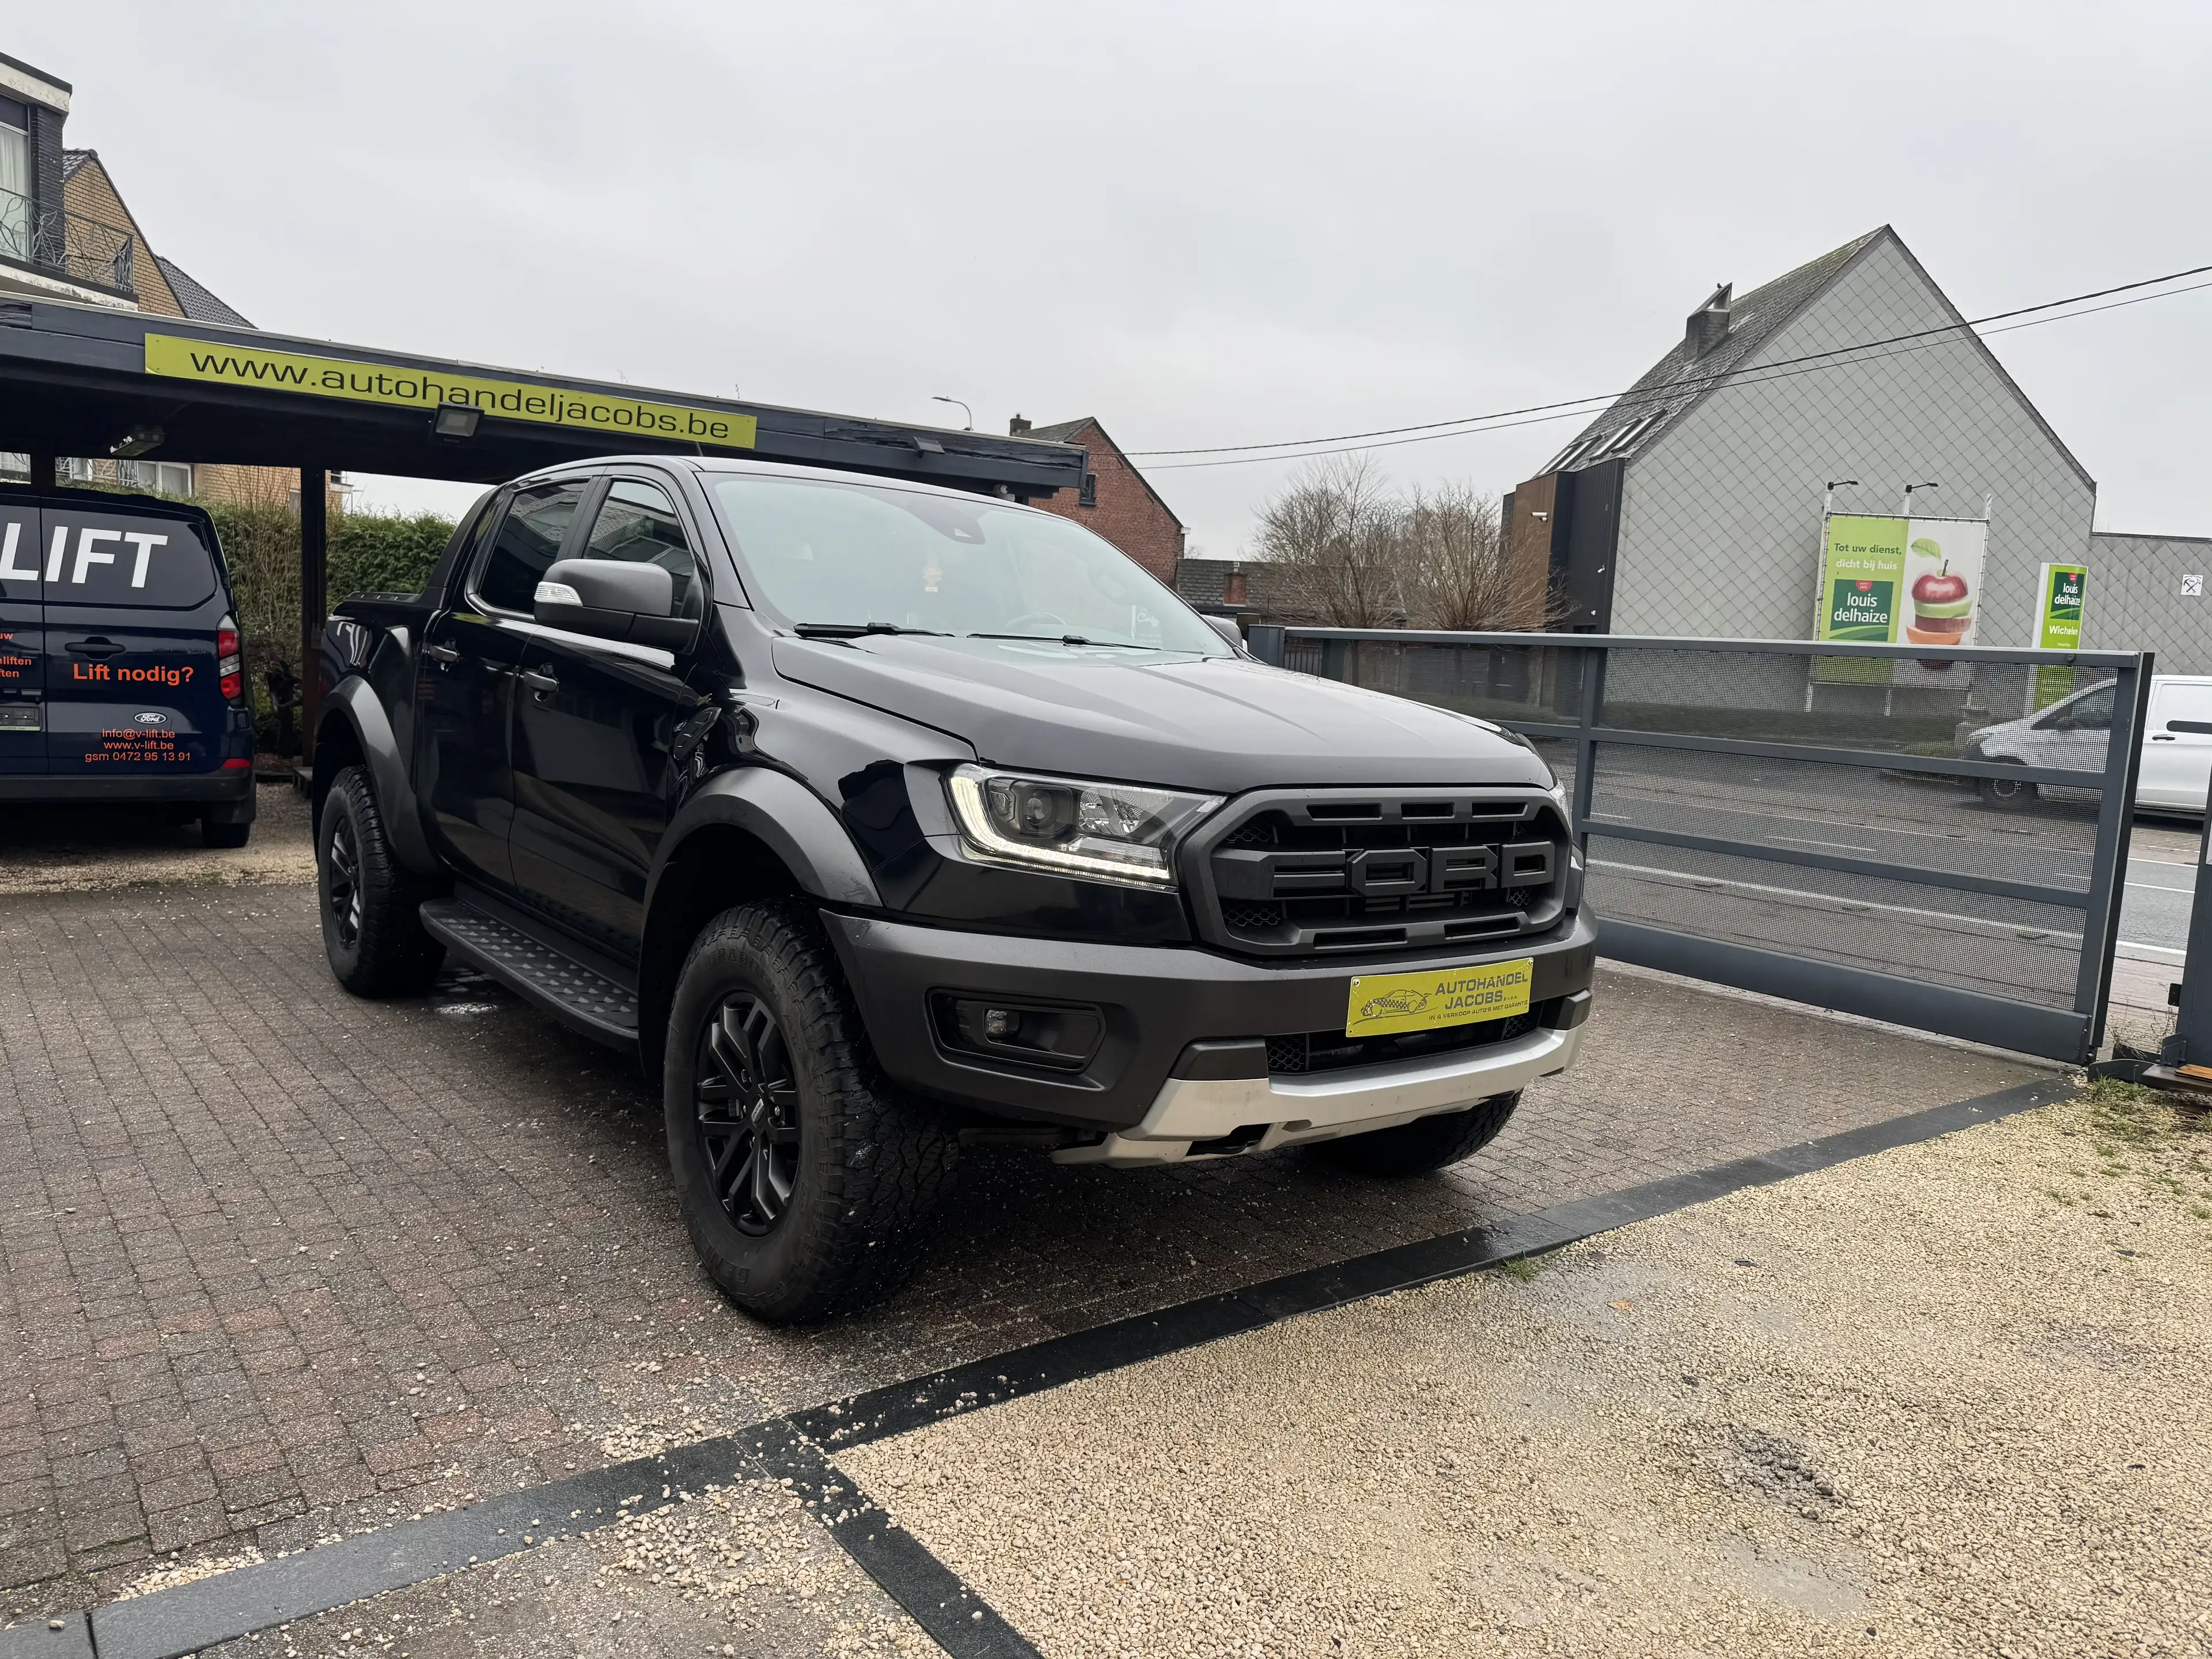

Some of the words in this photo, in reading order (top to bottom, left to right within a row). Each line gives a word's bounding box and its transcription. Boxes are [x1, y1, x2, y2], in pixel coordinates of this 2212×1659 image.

[191, 352, 730, 440] www.autohandeljacobs.be
[0, 522, 168, 588] LIFT
[1834, 543, 1849, 551] Tot
[1870, 544, 1902, 555] dienst,
[1836, 559, 1860, 568] dicht
[1863, 559, 1875, 571] bij
[1878, 560, 1897, 570] huis
[2063, 582, 2078, 594] louis
[1847, 592, 1877, 607] louis
[2054, 594, 2081, 605] delhaize
[1834, 608, 1888, 623] delhaize
[2049, 625, 2078, 635] Wichelen
[73, 663, 110, 680] Lift
[118, 666, 194, 687] nodig?
[101, 728, 175, 740] info@v-lift.be
[104, 740, 174, 749] www.v-lift.be
[85, 753, 109, 762] gsm
[113, 752, 141, 761] 0472
[144, 752, 158, 761] 95
[162, 752, 175, 761] 13
[178, 752, 191, 761] 91
[1213, 841, 1555, 900] FORD
[1435, 971, 1528, 995] AUTOHANDEL
[1445, 990, 1503, 1010] JACOBS
[1443, 1010, 1471, 1018] VERKOOP
